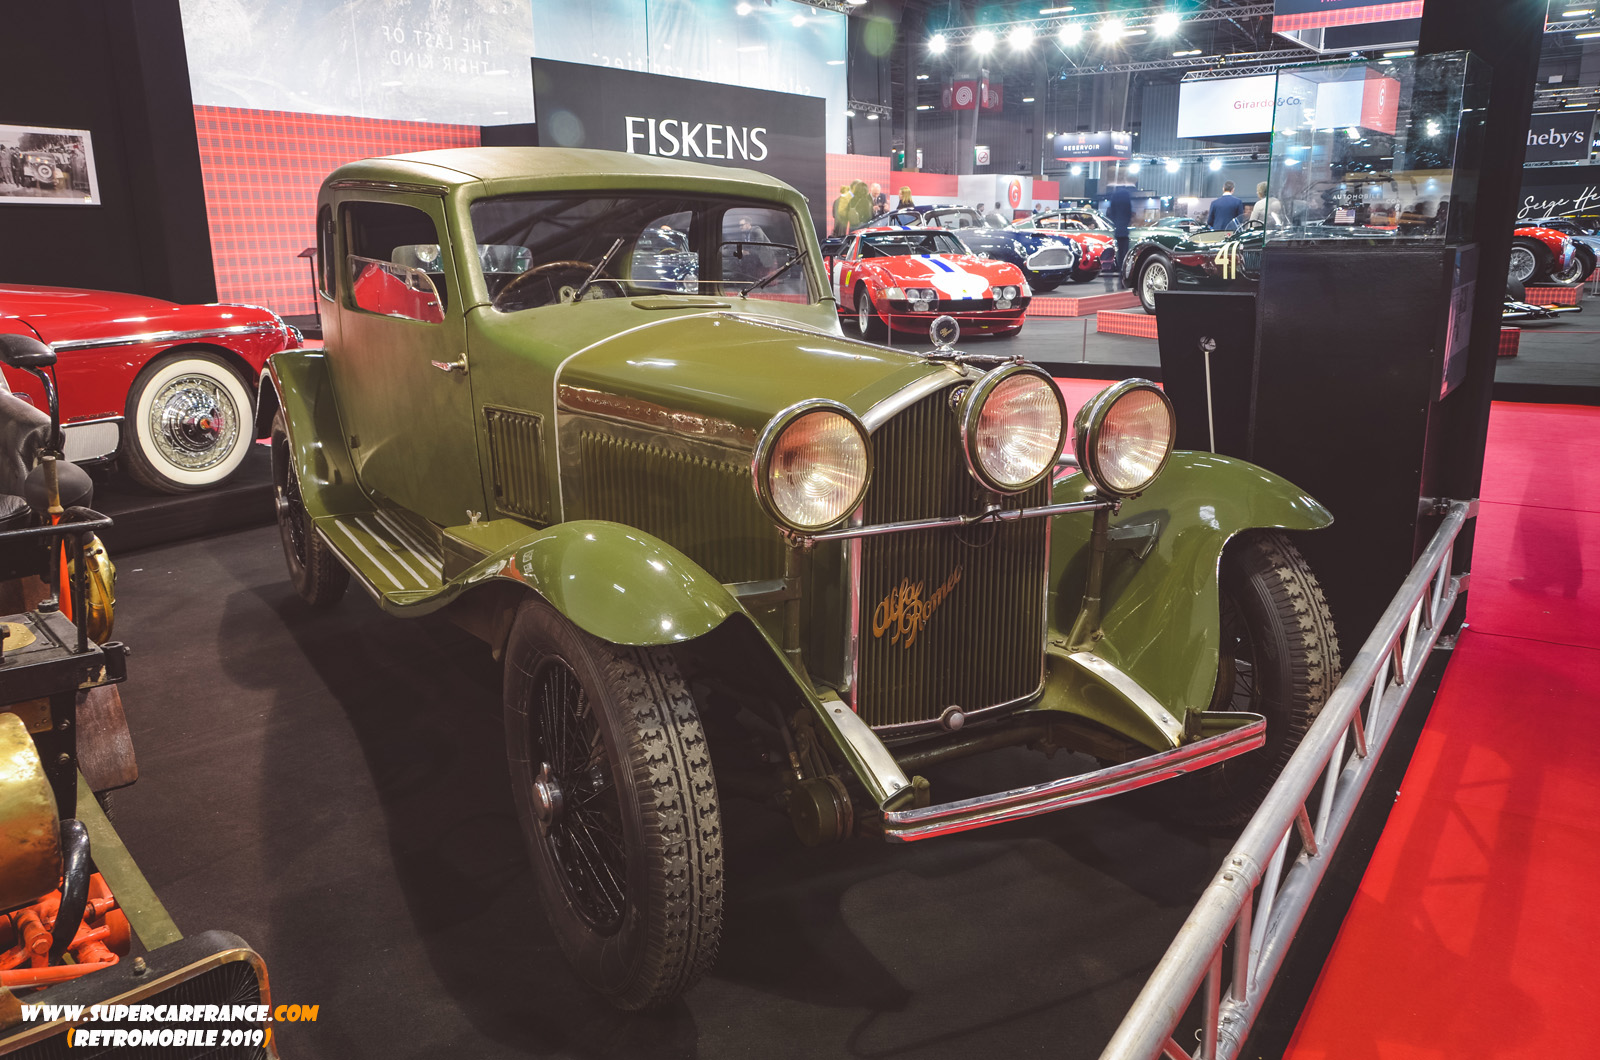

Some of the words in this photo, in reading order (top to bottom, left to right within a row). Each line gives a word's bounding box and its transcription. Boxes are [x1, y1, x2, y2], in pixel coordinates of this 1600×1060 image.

[1233, 98, 1274, 110] Girardo
[1276, 97, 1285, 106] &
[1286, 96, 1302, 106] Co.
[625, 116, 768, 161] FISKENS
[1526, 128, 1584, 148] heby's
[1517, 195, 1570, 219] Serge
[1573, 186, 1600, 212] He
[1214, 240, 1240, 279] 41
[899, 564, 964, 649] Romeo
